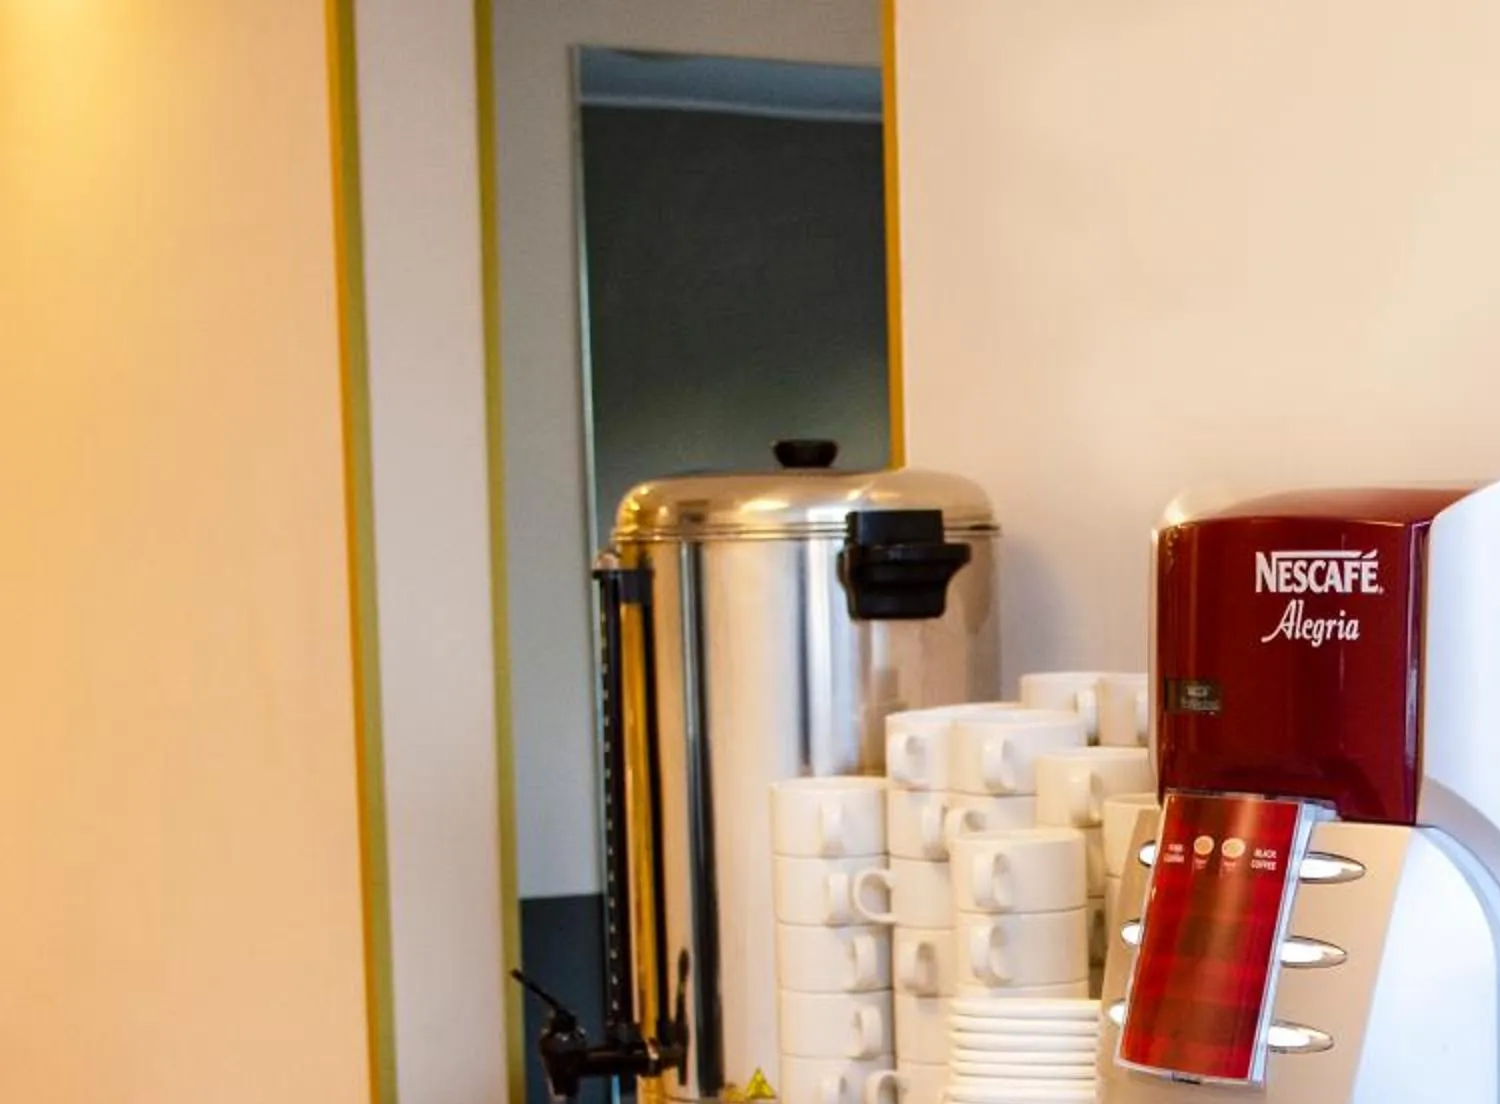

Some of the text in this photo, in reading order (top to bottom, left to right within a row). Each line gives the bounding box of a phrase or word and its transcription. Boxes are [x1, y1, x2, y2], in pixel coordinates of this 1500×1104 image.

[1255, 548, 1380, 594] NESCAFÉ
[1260, 598, 1361, 647] Alegria
[1251, 859, 1277, 871] COFFEE
